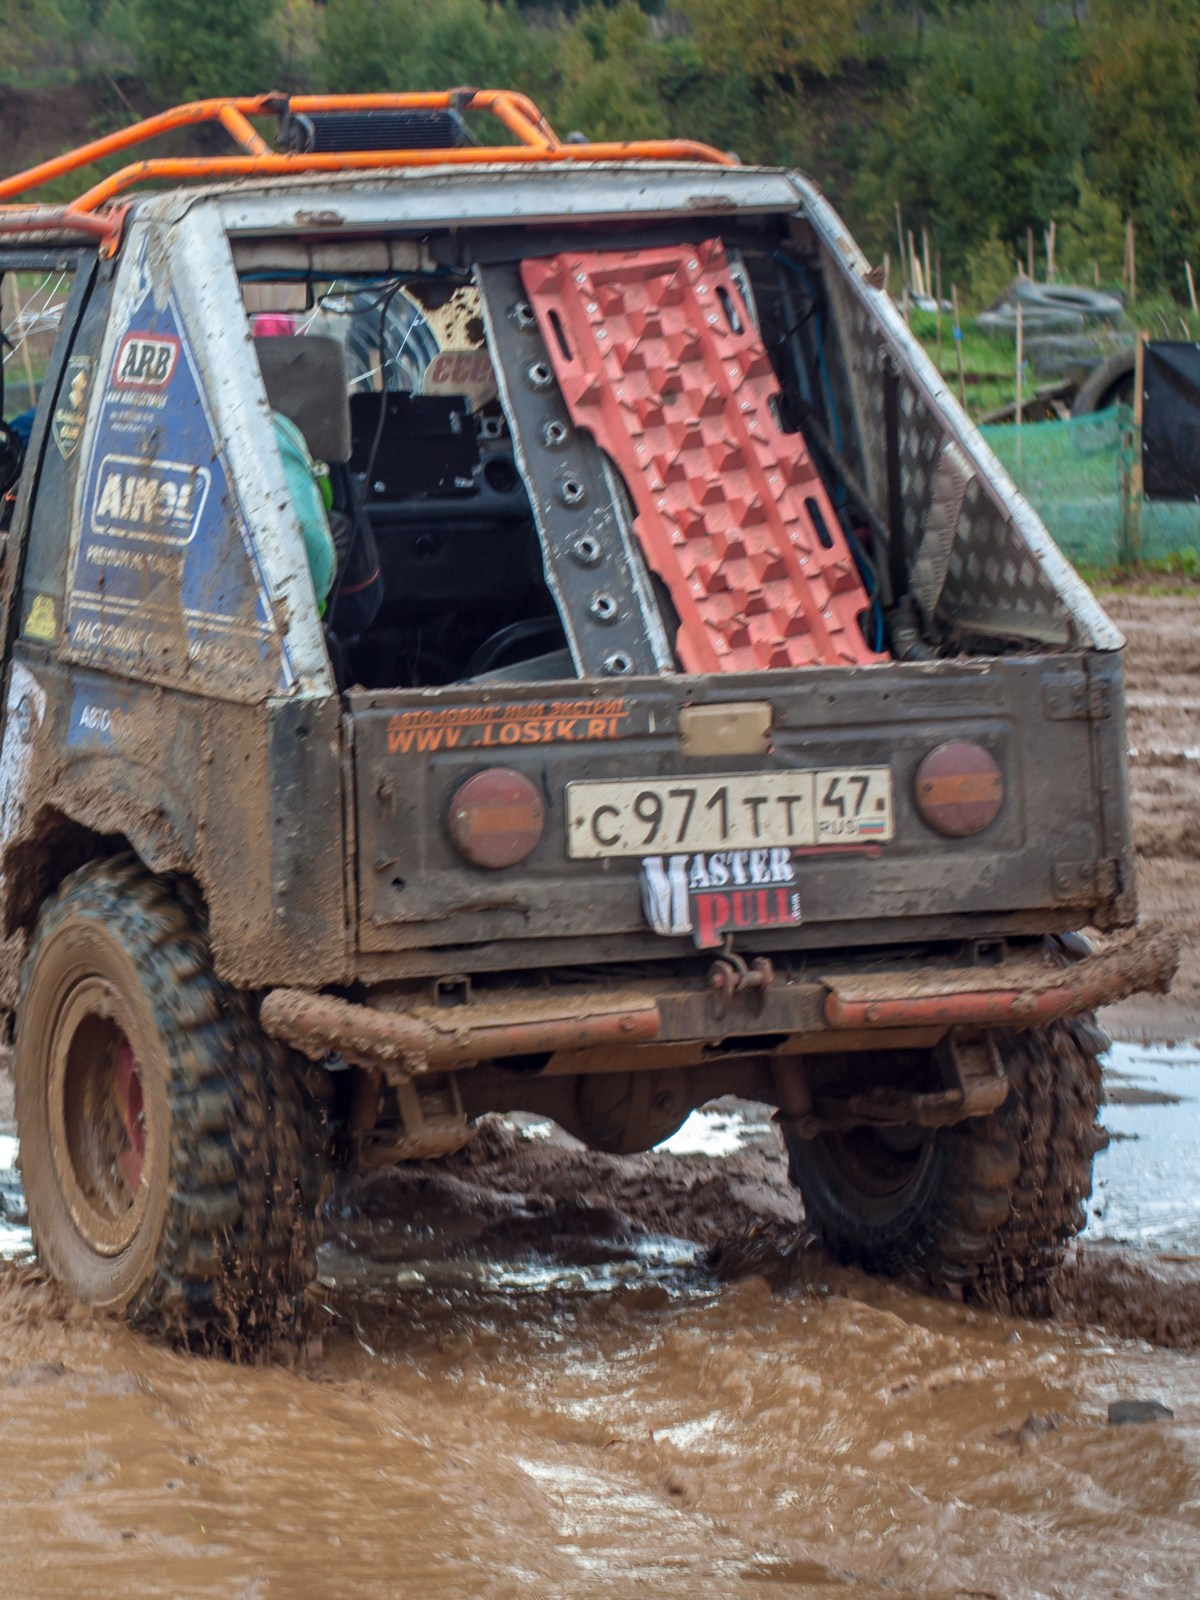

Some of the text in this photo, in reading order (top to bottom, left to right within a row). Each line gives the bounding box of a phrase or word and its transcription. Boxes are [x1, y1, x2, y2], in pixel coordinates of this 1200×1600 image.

[121, 344, 171, 380] ARB
[822, 775, 870, 817] 47
[819, 820, 857, 834] RUS
[642, 847, 795, 934] MASTER
